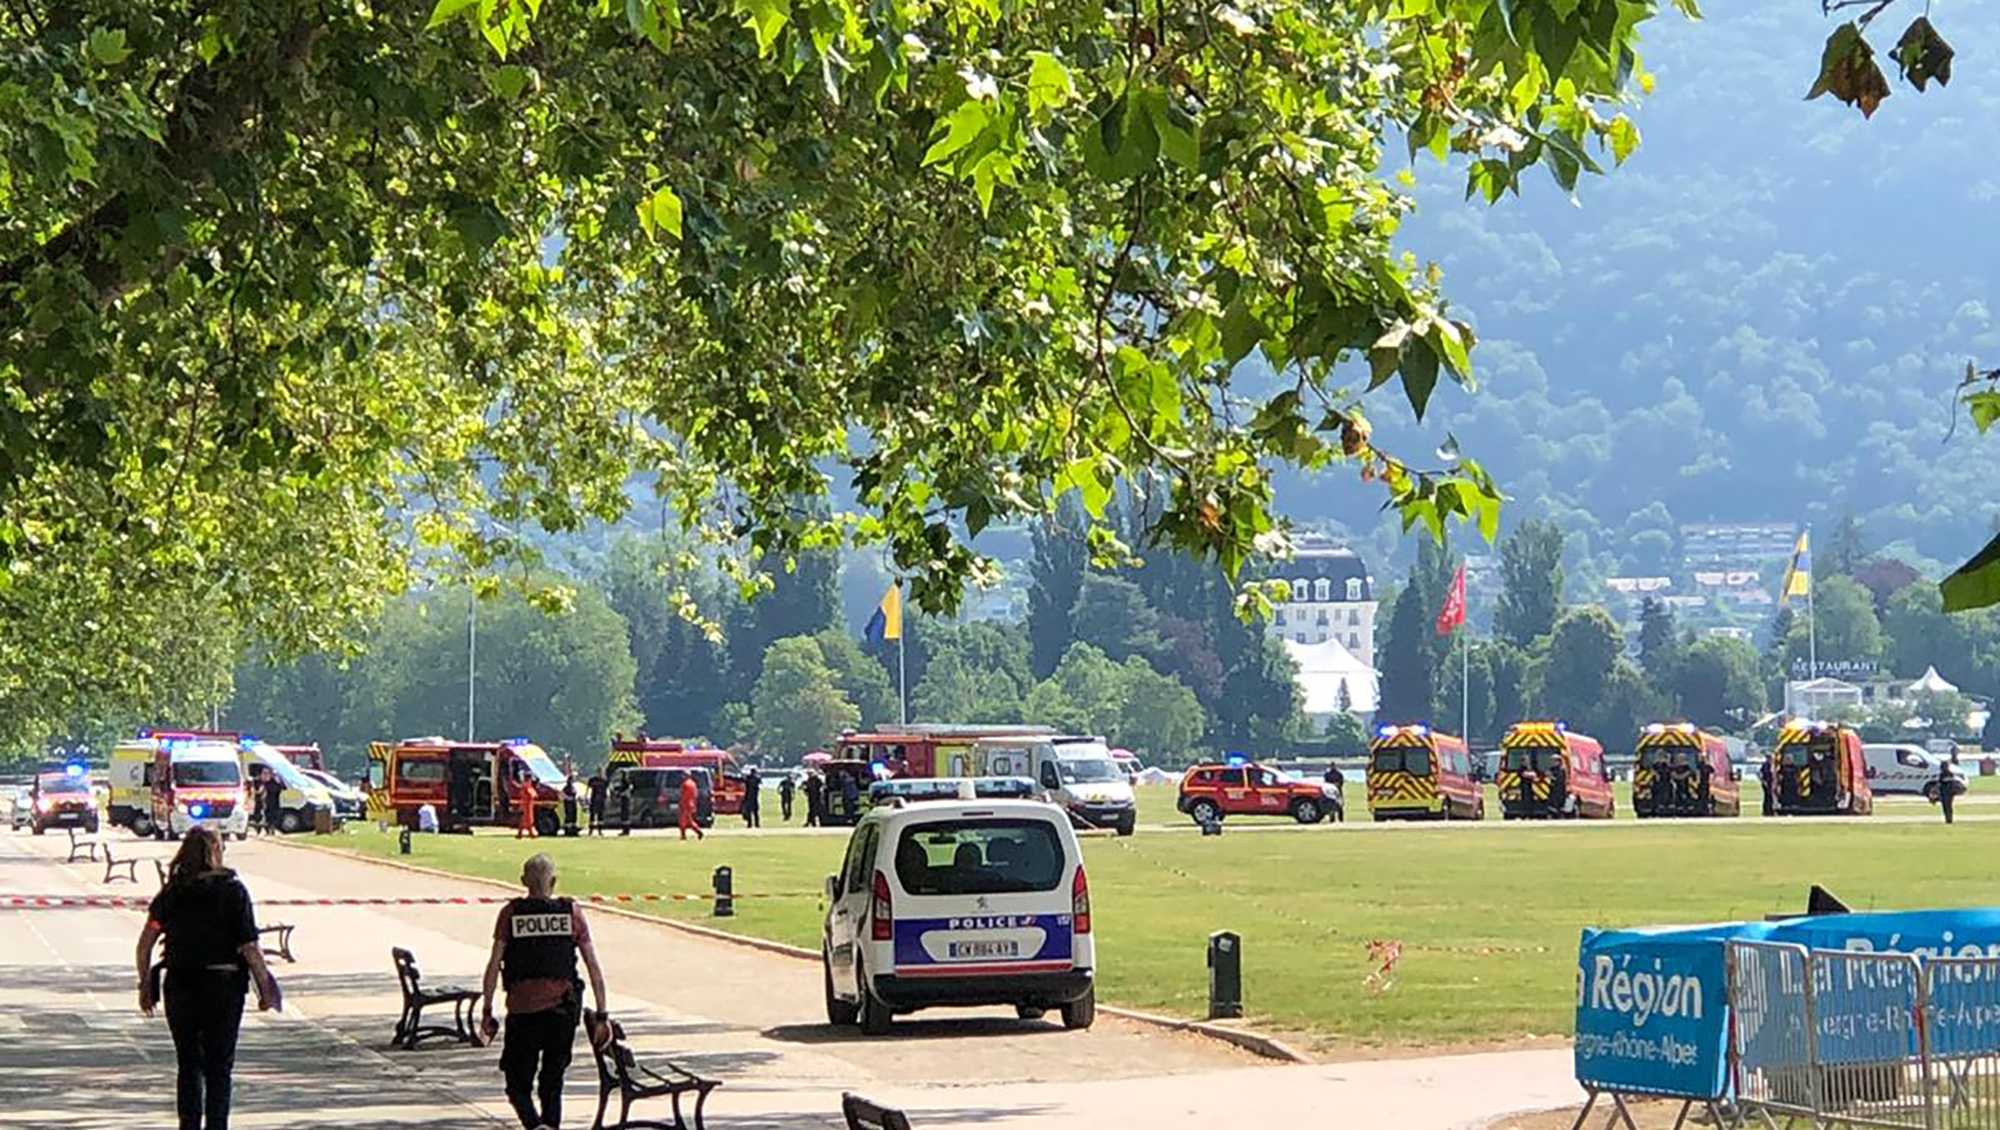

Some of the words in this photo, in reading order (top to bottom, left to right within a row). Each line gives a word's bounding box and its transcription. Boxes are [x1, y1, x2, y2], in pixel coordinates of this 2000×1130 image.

[1792, 661, 1878, 673] RESTAURANT
[516, 916, 569, 934] POLICE
[949, 917, 1017, 929] POLICE
[1591, 953, 1702, 1027] Région
